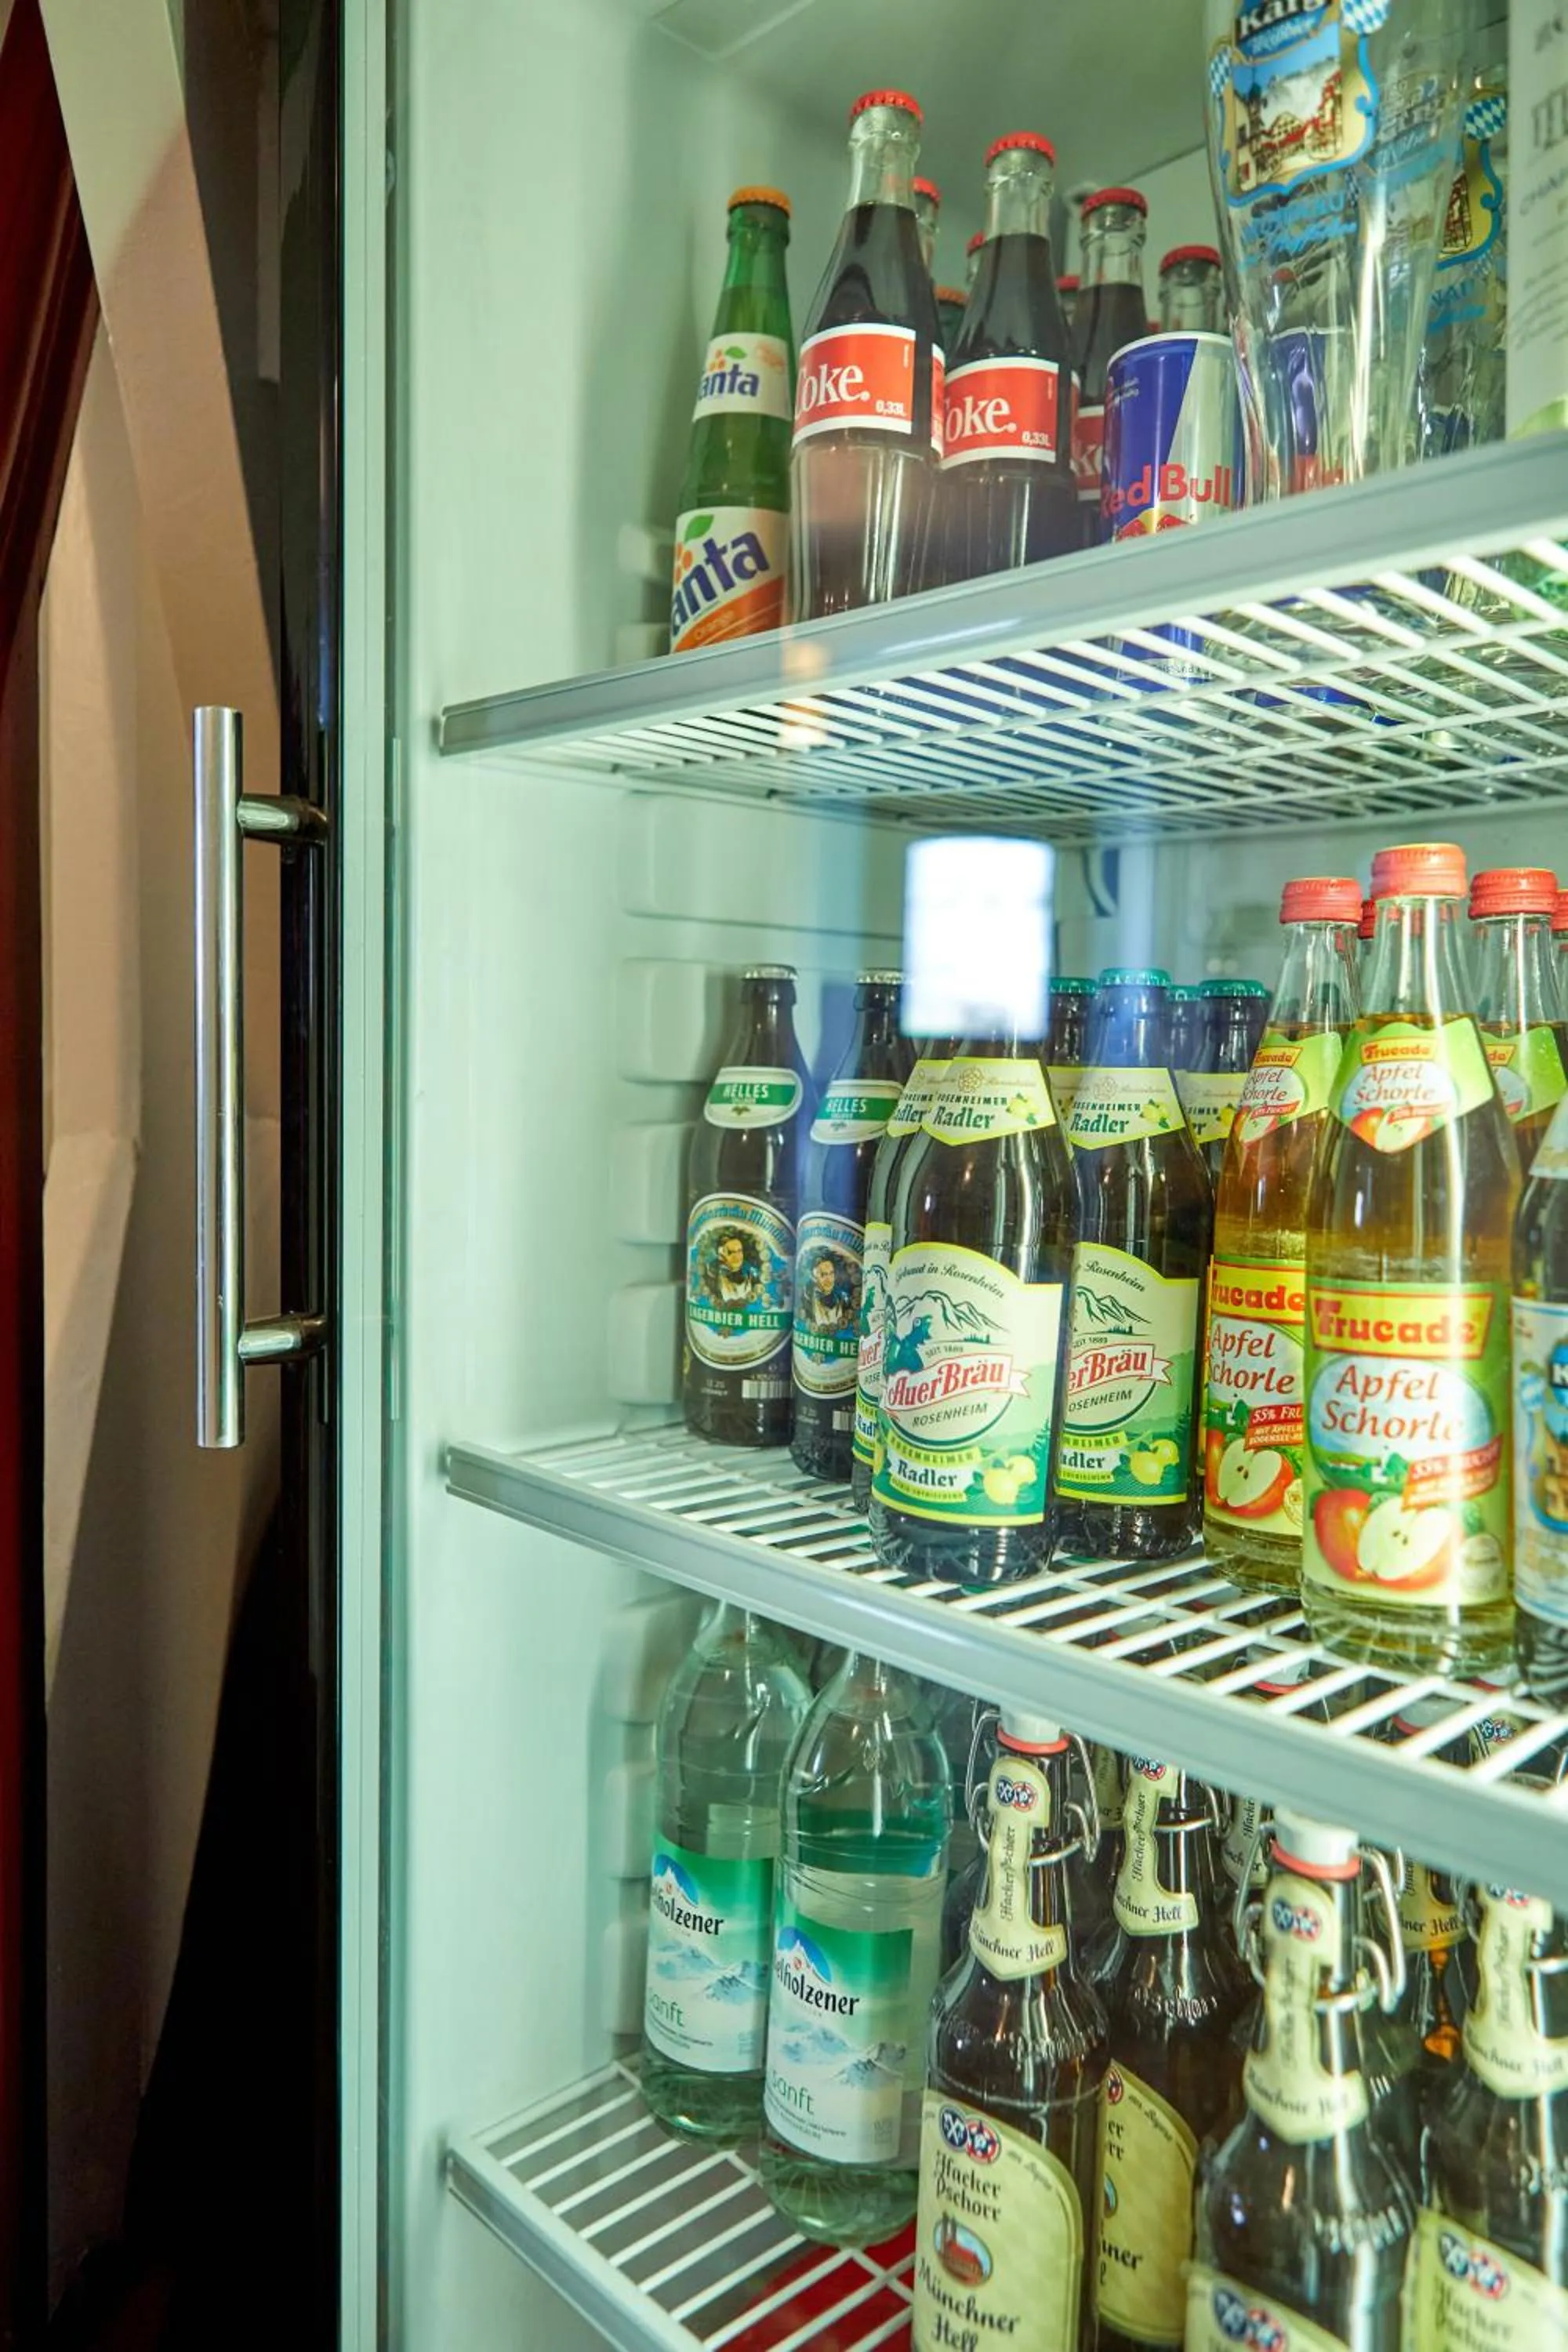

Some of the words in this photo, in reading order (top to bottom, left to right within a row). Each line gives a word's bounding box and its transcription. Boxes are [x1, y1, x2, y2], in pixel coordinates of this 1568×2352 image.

[699, 363, 759, 399] anta
[945, 396, 1017, 441] oke.
[1159, 463, 1231, 508] Bull
[672, 532, 770, 637] anta
[1364, 1044, 1430, 1060] Trucade
[1364, 1063, 1422, 1083] Apfel
[722, 1083, 769, 1099] HELLES
[826, 1098, 867, 1113] HELLES
[1355, 1083, 1434, 1105] Schorle
[933, 1105, 995, 1129] Radler
[1070, 1112, 1130, 1134] Radler
[1084, 1261, 1145, 1293] Rosenheim
[1211, 1270, 1305, 1312] rucade
[749, 1314, 779, 1327] HELL
[1315, 1299, 1478, 1345] Trucade
[1211, 1323, 1276, 1359] Apfel
[1068, 1350, 1147, 1391] erBräu
[1210, 1359, 1295, 1395] chorle
[1335, 1365, 1439, 1400] Apfel
[912, 1402, 989, 1428] ROSENHEIM
[1069, 1389, 1133, 1413] OSENHEIM
[1252, 1407, 1276, 1424] 55%
[1322, 1400, 1465, 1441] Schorle
[898, 1459, 958, 1487] Radler
[1152, 1904, 1183, 1924] Hell
[1025, 1938, 1055, 1963] Hell
[650, 1988, 686, 2028] anft
[935, 2150, 1001, 2201] Hacker
[935, 2176, 1001, 2222] Pschorr
[919, 2257, 1021, 2335] Münchner
[932, 2313, 979, 2352] Hell
